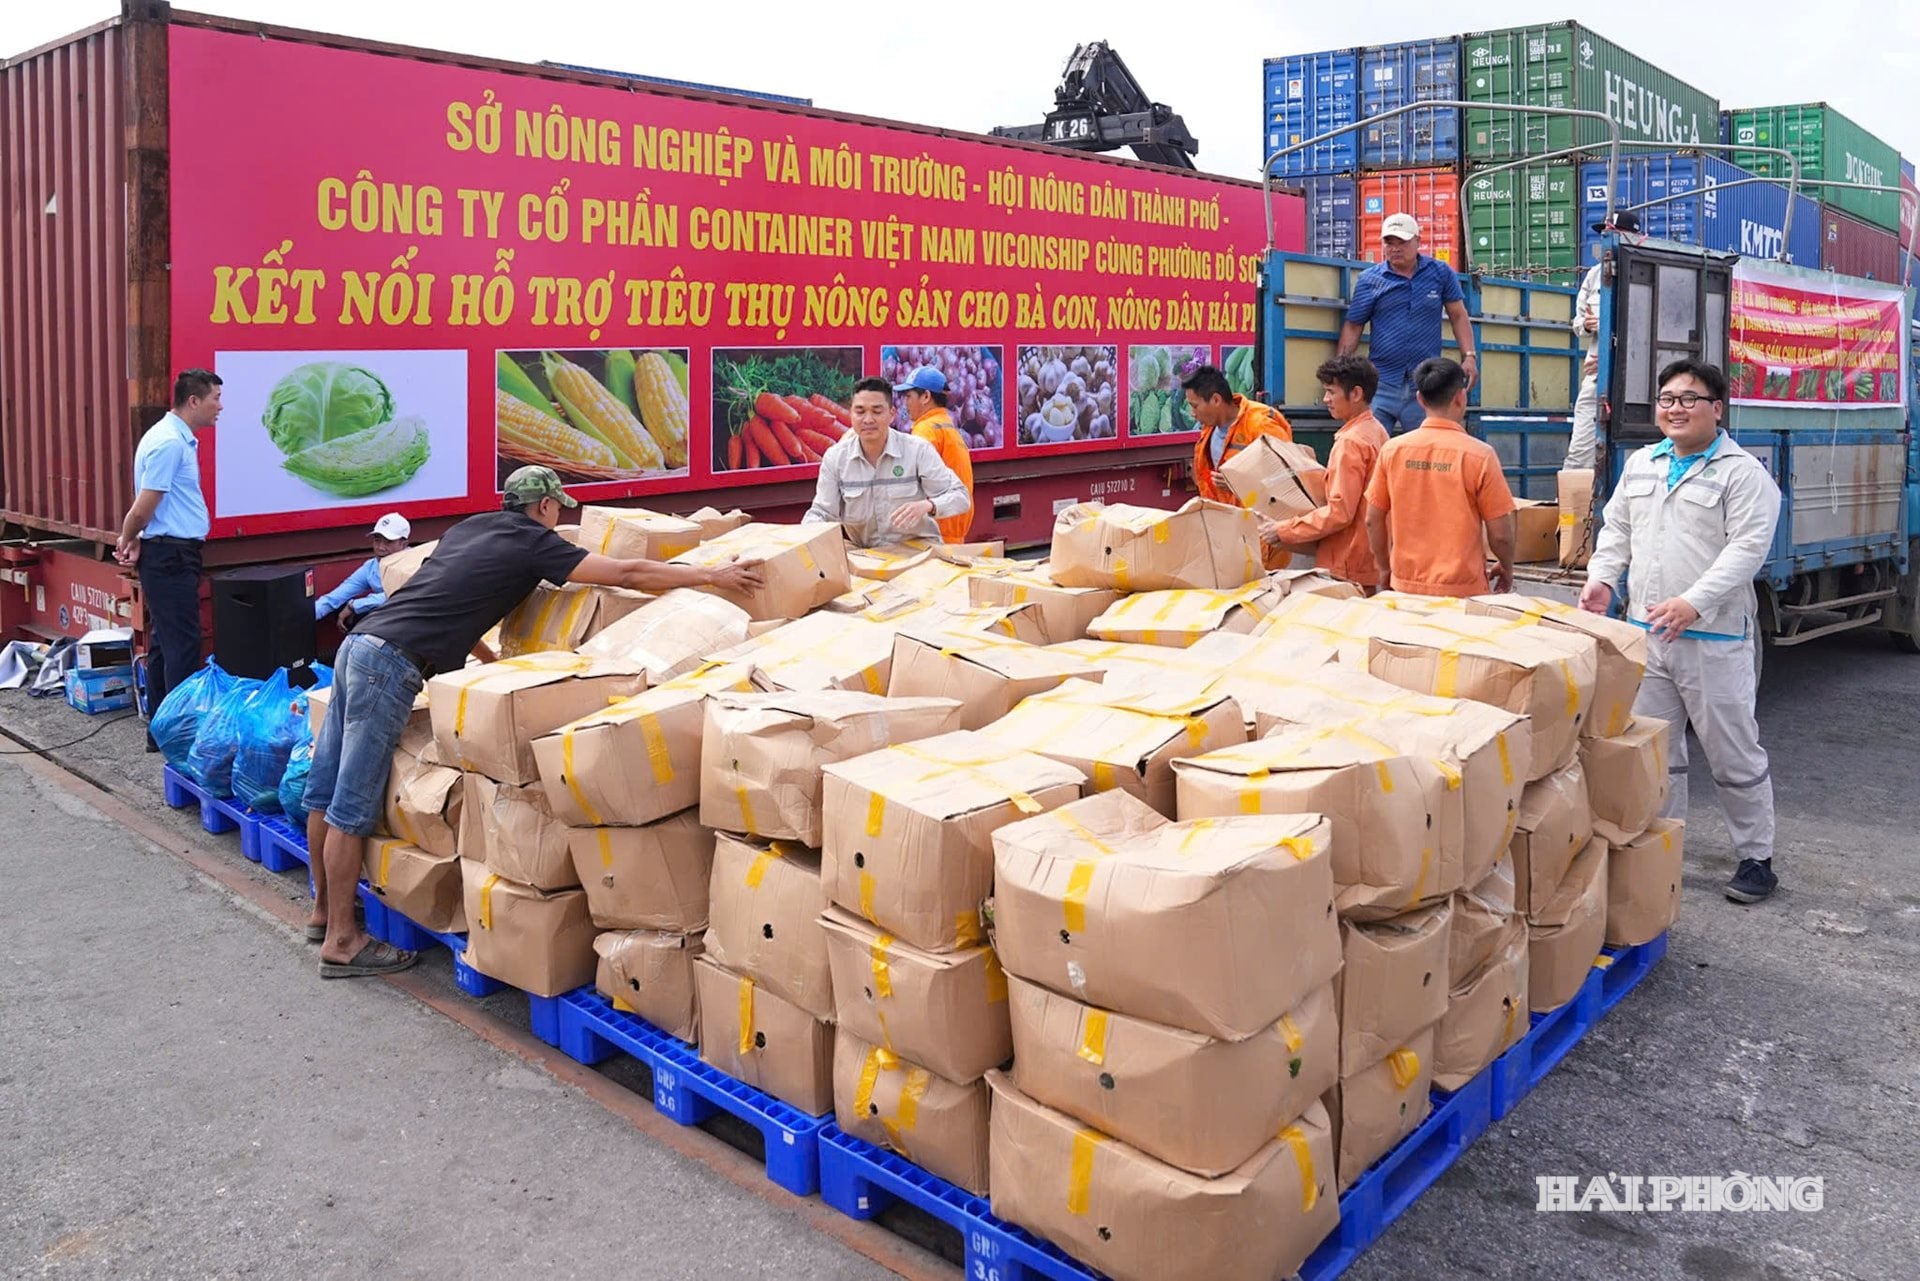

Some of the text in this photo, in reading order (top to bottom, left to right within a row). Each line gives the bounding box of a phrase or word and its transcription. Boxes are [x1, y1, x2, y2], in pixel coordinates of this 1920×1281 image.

[447, 89, 503, 154] SỞ
[515, 104, 621, 166] NÔNG
[633, 126, 754, 187] NGHIỆP
[762, 135, 801, 185] VÀ
[809, 143, 862, 191] MÔI
[869, 150, 966, 202] TRƯỜNG
[988, 165, 1024, 215] HỘI
[1030, 172, 1085, 215] NÔNG
[1090, 181, 1127, 219] DÂN
[1131, 190, 1185, 227] THÀNH
[1189, 193, 1220, 231] PHỐ
[317, 169, 443, 236] CÔNG
[456, 188, 505, 238] TY
[518, 177, 571, 243] CỔ
[582, 187, 678, 248] PHẦN
[689, 206, 853, 257] CONTAINER
[860, 214, 914, 269] VIỆT
[921, 225, 975, 265] NAM
[982, 230, 1090, 272] VICONSHIP
[1095, 236, 1143, 276] CÙNG
[1148, 239, 1212, 280] PHƯỜNG
[1215, 244, 1235, 282] ĐỒ
[209, 239, 326, 325] KẾT
[338, 245, 436, 325] NỐI
[447, 248, 515, 326] HỖ
[527, 271, 617, 341] TRỢ
[624, 265, 716, 327] TIÊU
[724, 282, 796, 340] THỤ
[802, 272, 889, 327] NÔNG
[896, 274, 953, 328] SẢN
[958, 290, 1010, 329] CHO
[1015, 282, 1046, 329] BÀ
[1052, 294, 1101, 336] CON,
[1106, 287, 1162, 331] NÔNG
[1166, 290, 1205, 331] DÂN
[1208, 291, 1238, 332] HẢI
[1090, 478, 1135, 496] CAIU 572710 2
[1405, 459, 1453, 472] GREEN PORT
[658, 1089, 676, 1112] 3.6
